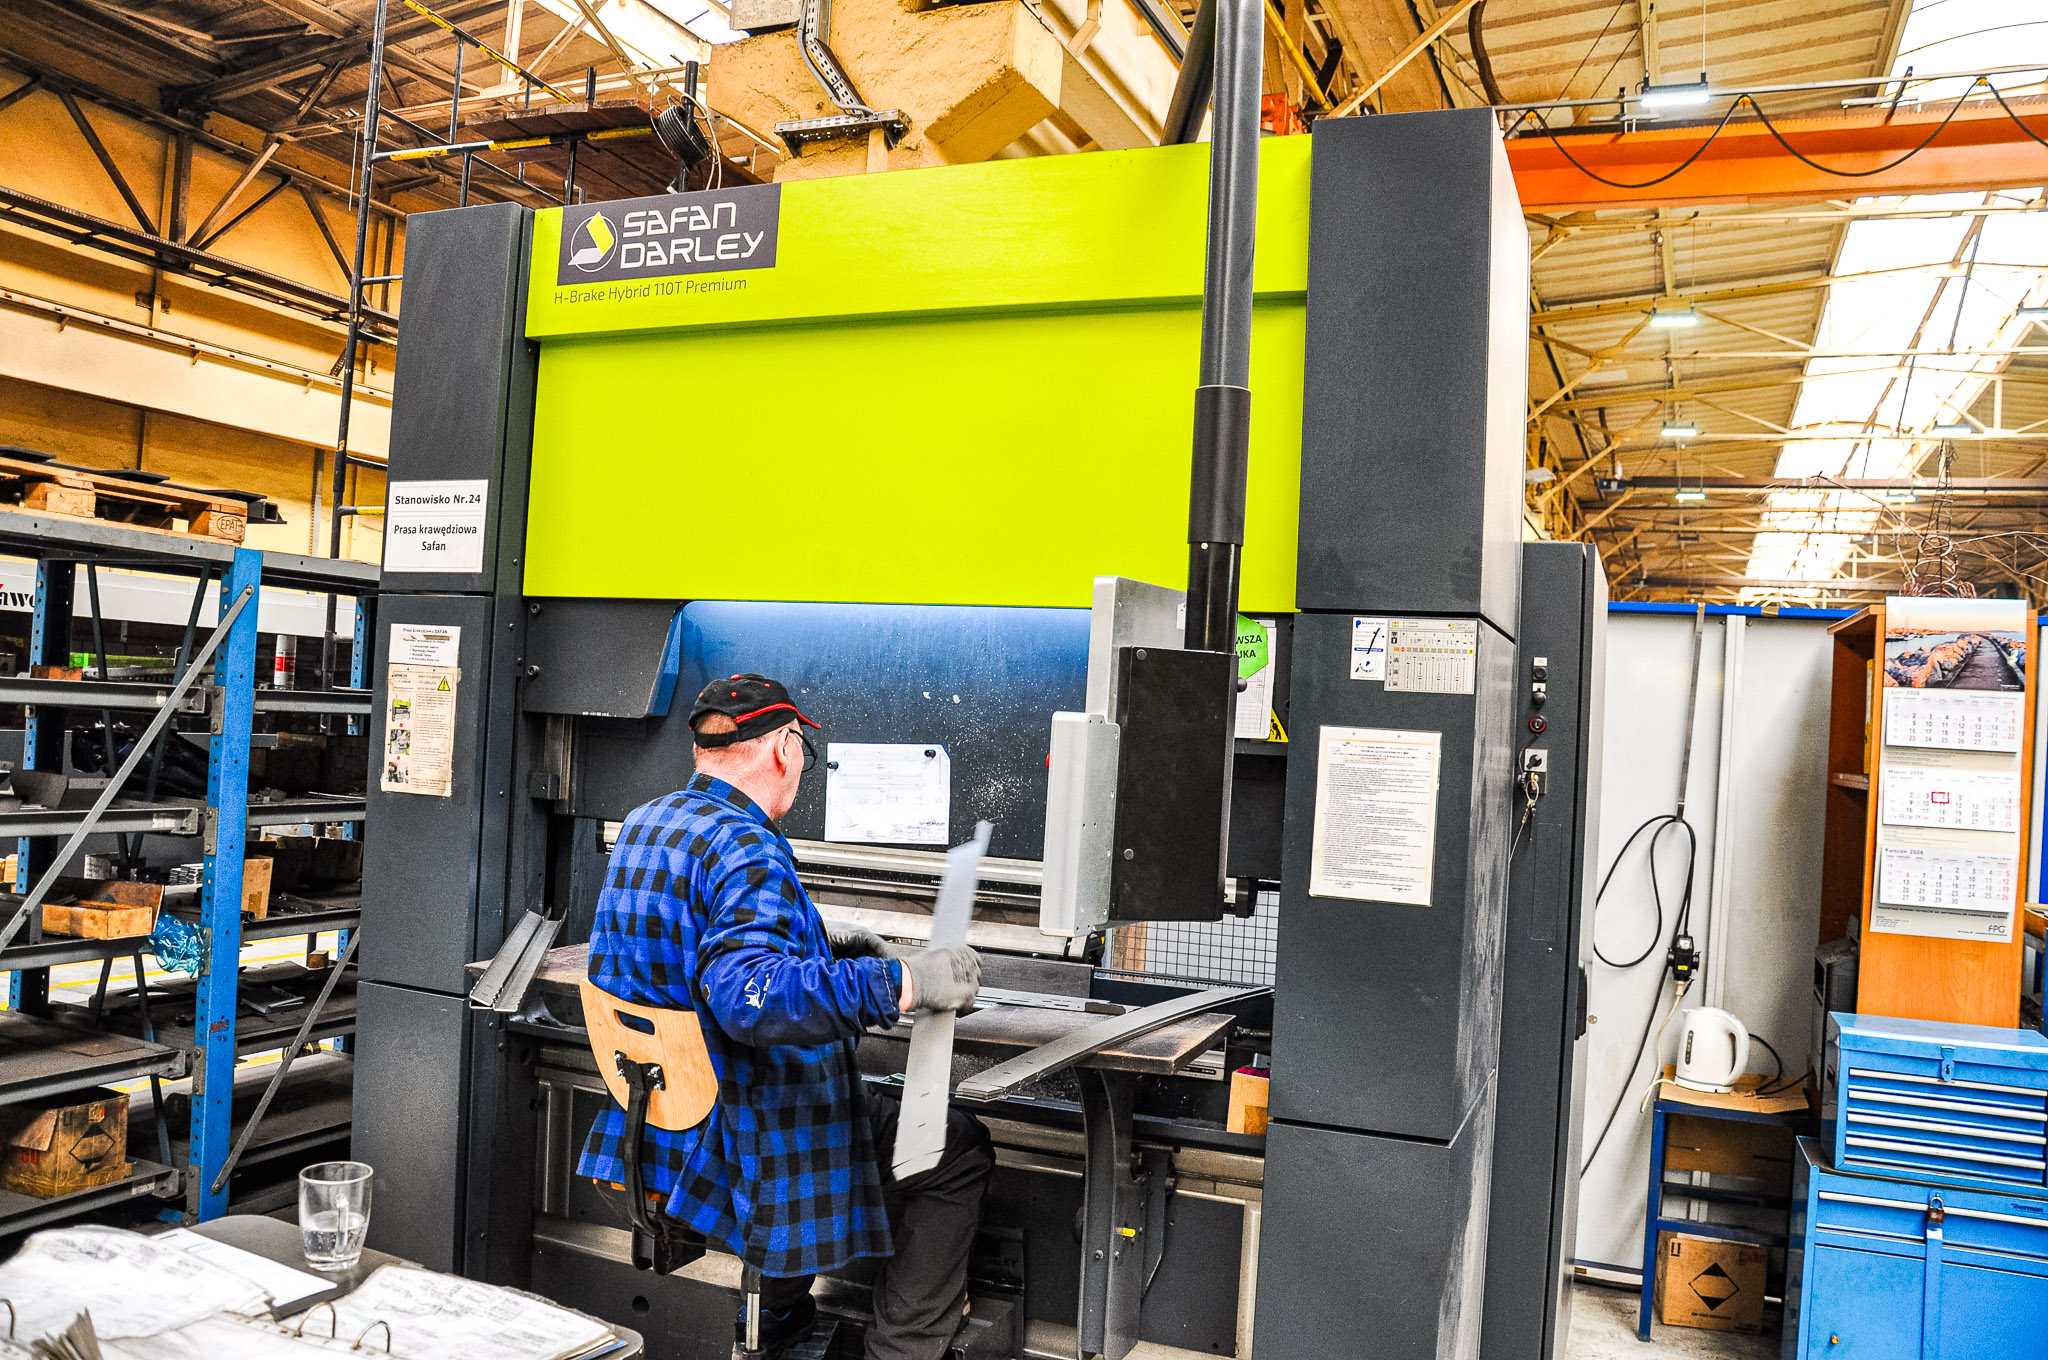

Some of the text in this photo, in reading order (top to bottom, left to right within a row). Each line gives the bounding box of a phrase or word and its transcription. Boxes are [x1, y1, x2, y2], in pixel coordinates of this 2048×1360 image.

[619, 230, 764, 270] DARLEY
[554, 278, 747, 304] H-Brake Hybrid 110T Premium
[394, 494, 481, 505] Stanowisko Nr.24
[394, 524, 477, 536] Prasa krawędziowa
[421, 540, 446, 551] Safan
[1988, 925, 2006, 933] FPG
